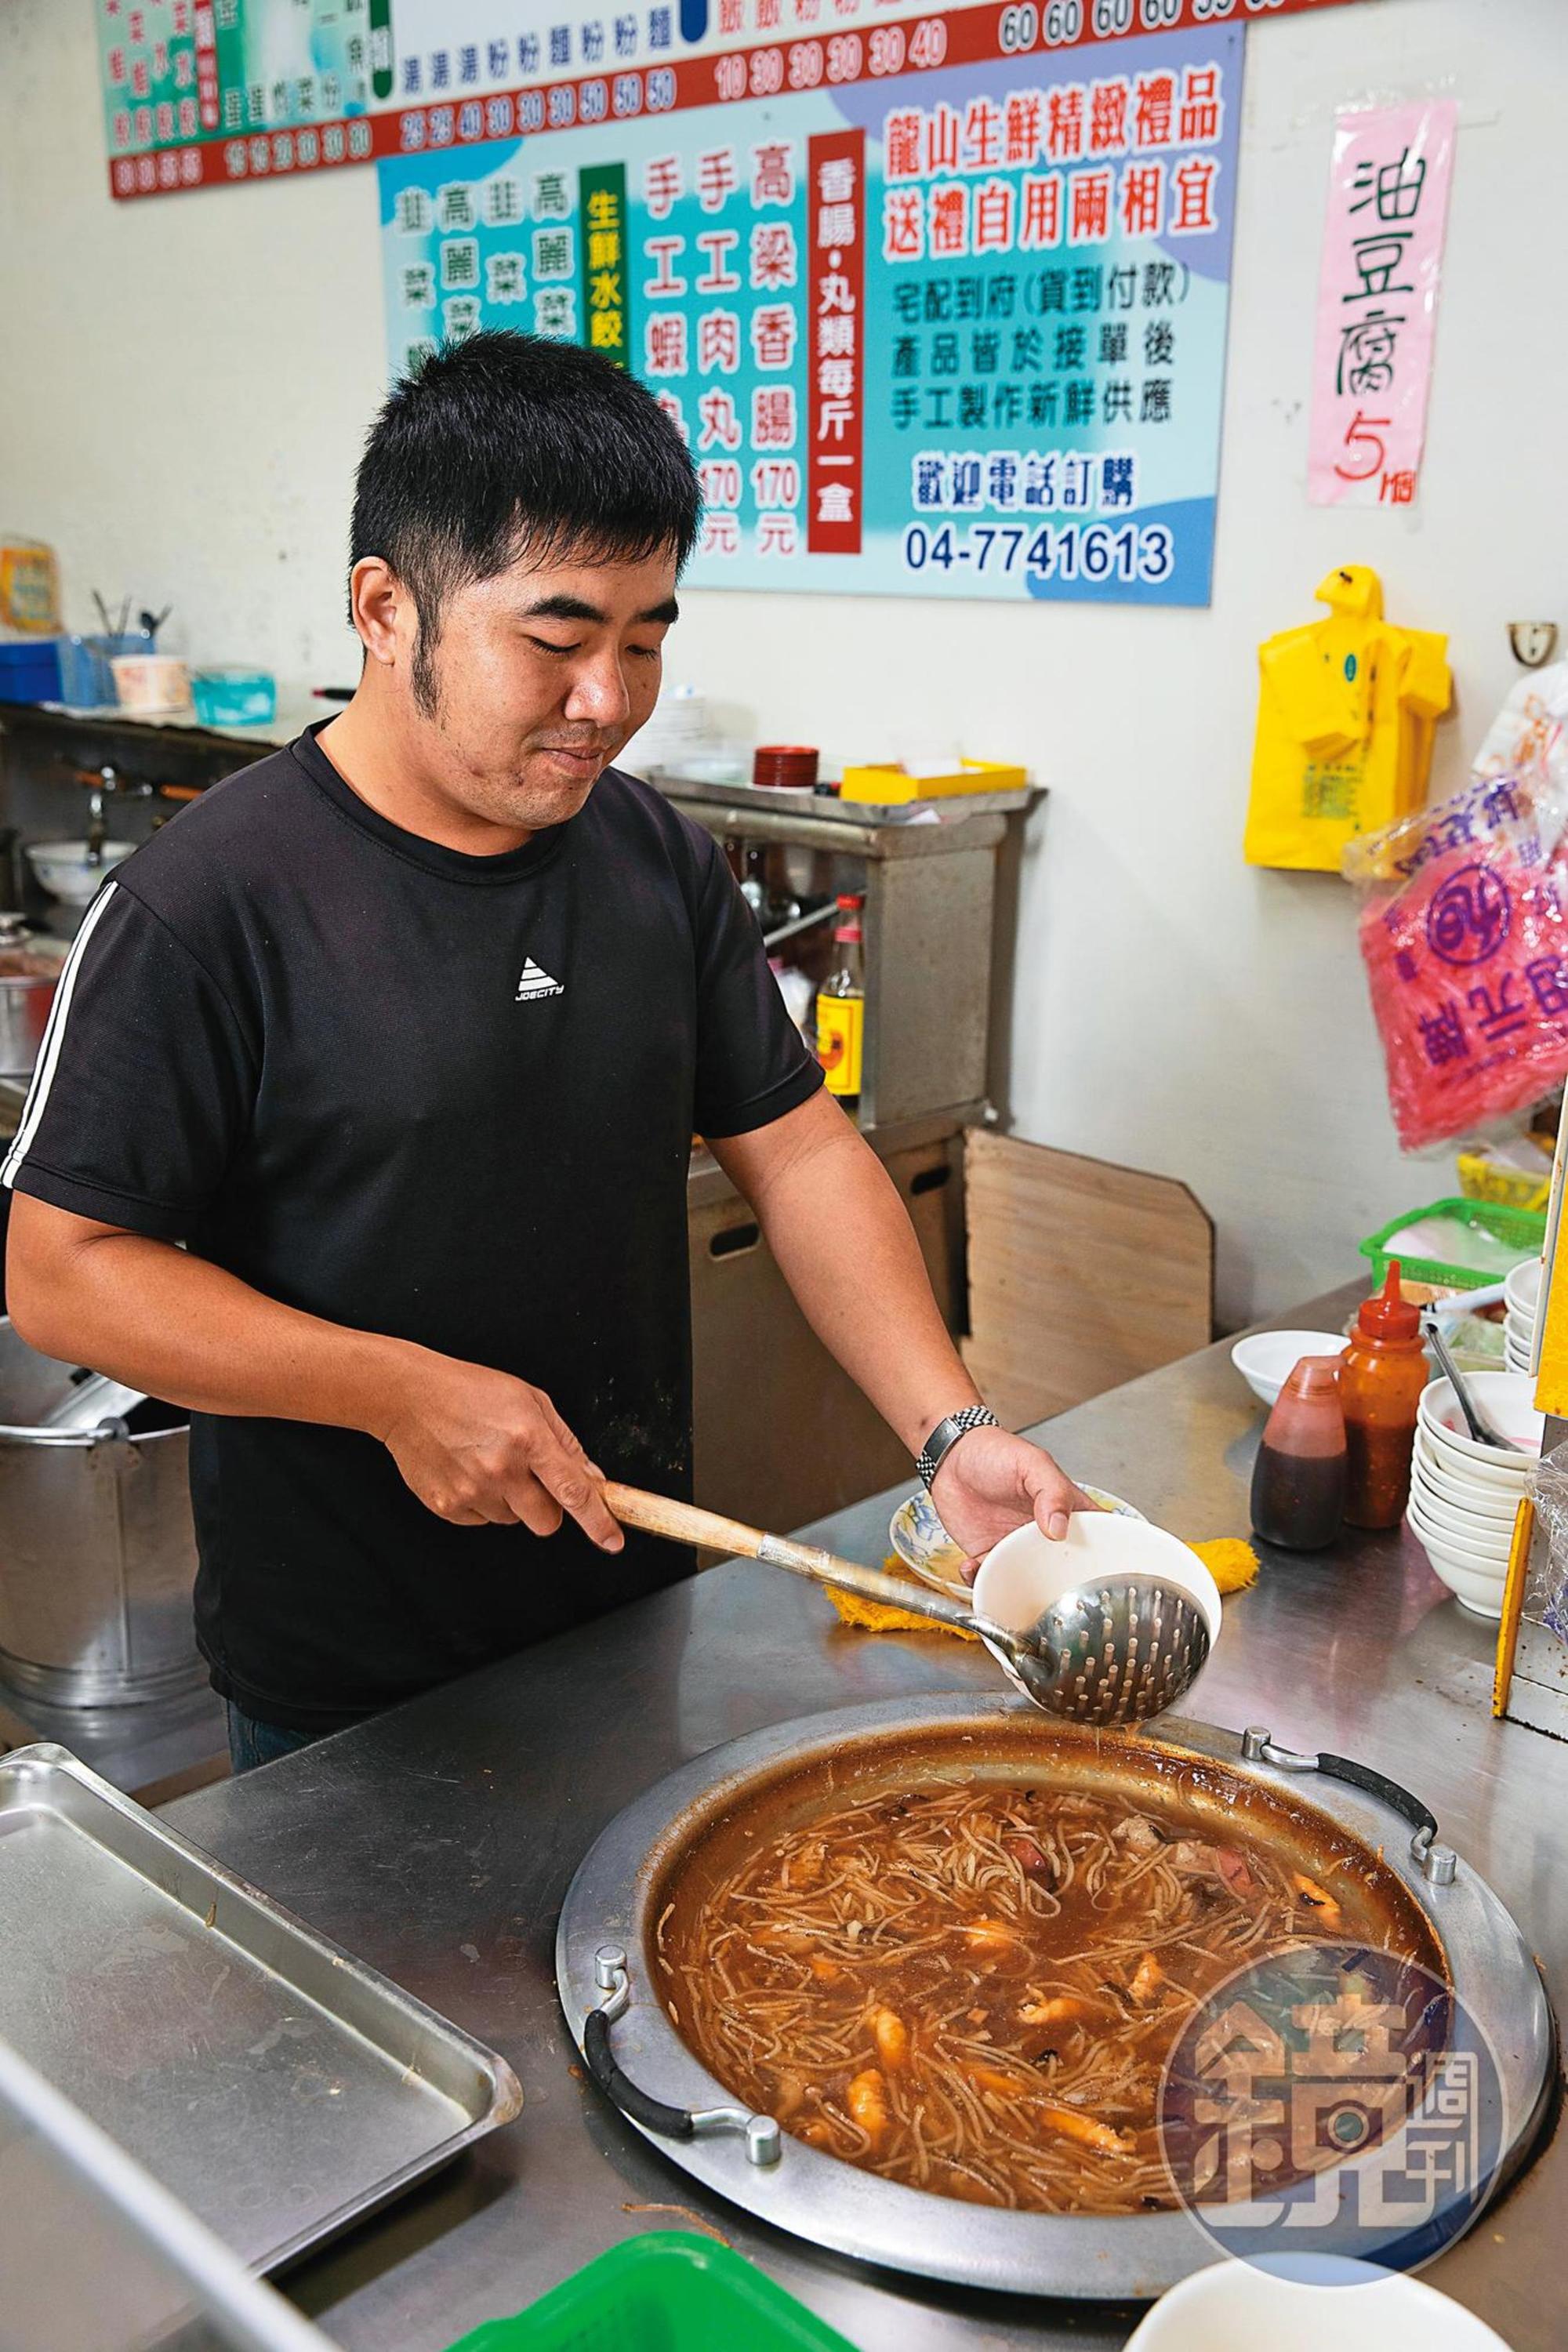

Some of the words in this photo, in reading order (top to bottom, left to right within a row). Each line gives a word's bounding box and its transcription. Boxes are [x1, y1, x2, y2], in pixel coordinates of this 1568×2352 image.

[1003, 8, 1036, 49] 60
[1047, 1, 1080, 43] 60
[716, 58, 746, 100] 10
[750, 49, 783, 94] 30
[789, 42, 822, 88] 30
[828, 35, 861, 81] 30
[869, 28, 904, 74] 30
[909, 20, 946, 66] 40
[887, 161, 1215, 256] 送禮自用兩相宜
[586, 189, 624, 368] 生鮮水餃
[1335, 147, 1427, 395] 油豆腐
[917, 457, 1133, 506] 歡迎電話訂購
[906, 528, 1168, 576] 04-7741613
[514, 985, 564, 1001] JOECITY
